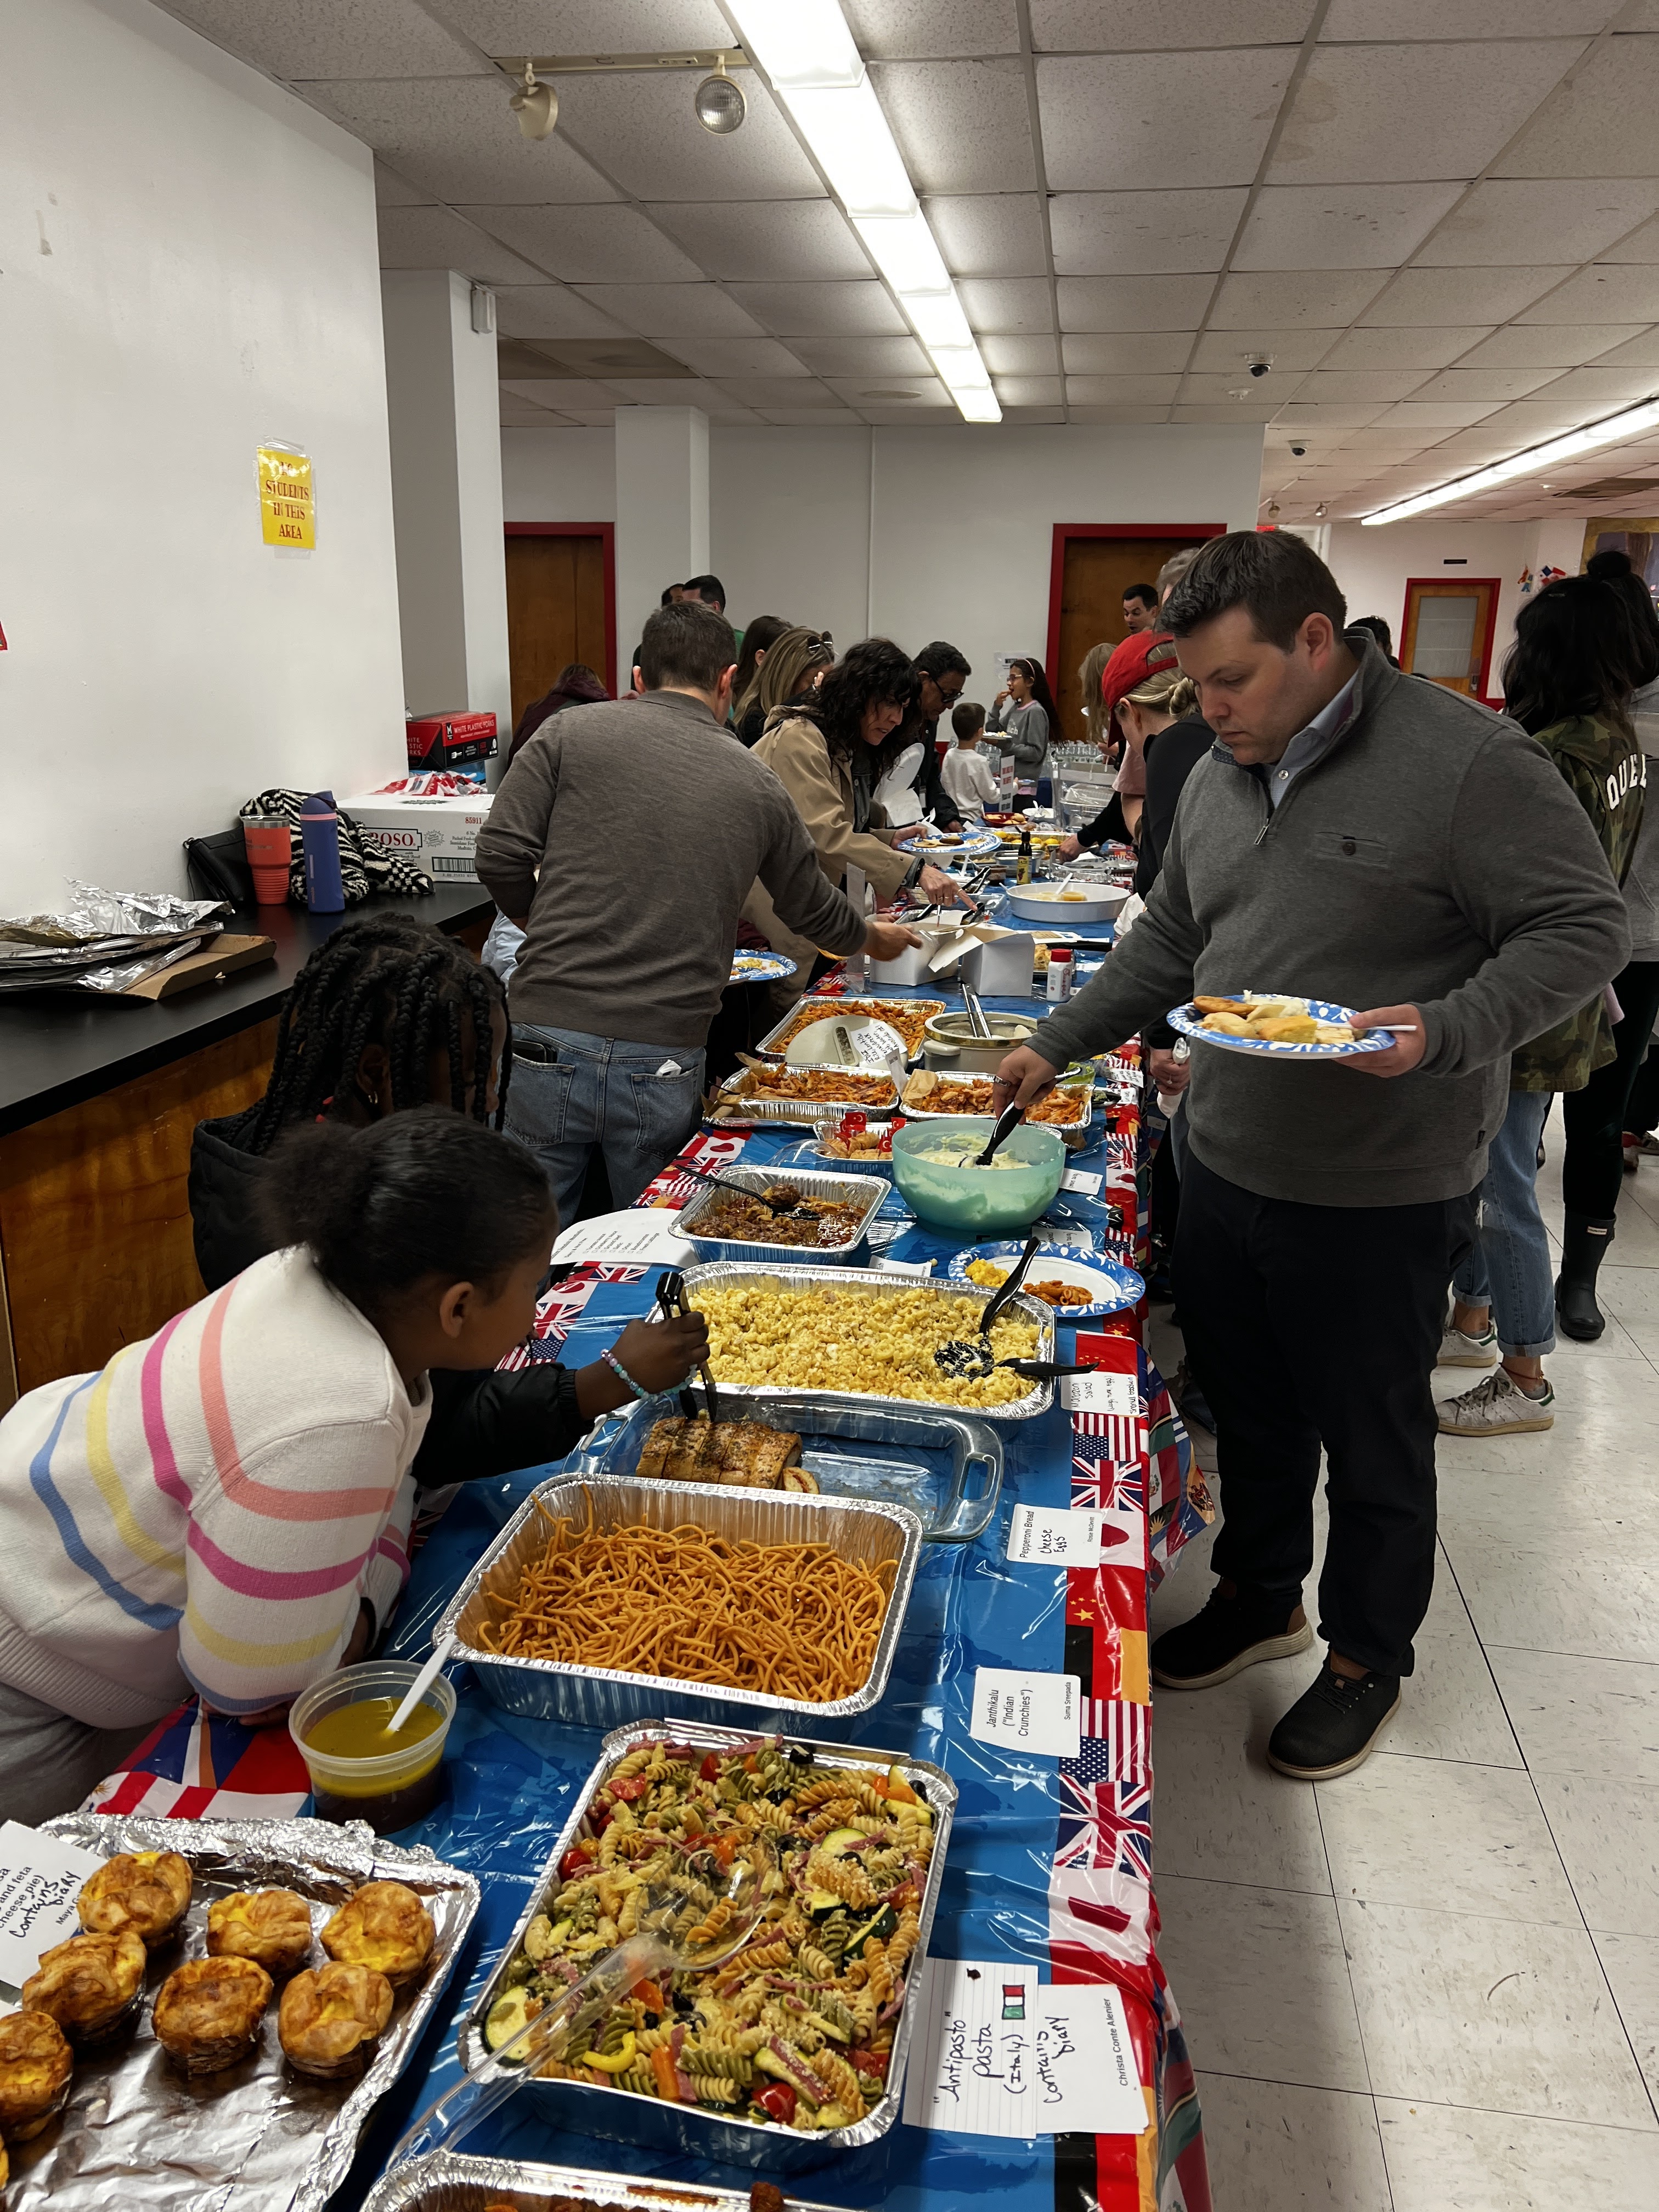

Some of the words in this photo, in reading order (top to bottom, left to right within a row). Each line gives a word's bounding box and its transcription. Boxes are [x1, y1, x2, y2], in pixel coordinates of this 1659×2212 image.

[266, 479, 309, 500] STUDENTS
[273, 503, 283, 515] IN
[285, 504, 305, 520] THIS
[279, 524, 302, 539] AREA
[454, 725, 467, 733] WHITE
[467, 723, 483, 731] PLASTIC
[483, 720, 494, 729] FORKS
[1024, 1511, 1034, 1527] Bread
[1019, 1528, 1032, 1558] Pepperoni
[1064, 1682, 1073, 1705] Sreepada
[986, 1690, 999, 1728] Janthikalu
[1002, 1696, 1015, 1726] ("Indian
[1018, 1689, 1034, 1736] Crunchies")
[12, 1866, 32, 1884] feta
[25, 1874, 45, 1896] pie)
[55, 1906, 76, 1925] Maya
[1103, 1998, 1116, 2025] Alenier
[972, 2023, 1005, 2078] pasta
[1110, 2027, 1121, 2053] Conte
[1000, 2034, 1030, 2094] (Italy)
[1116, 2055, 1128, 2086] Christa
